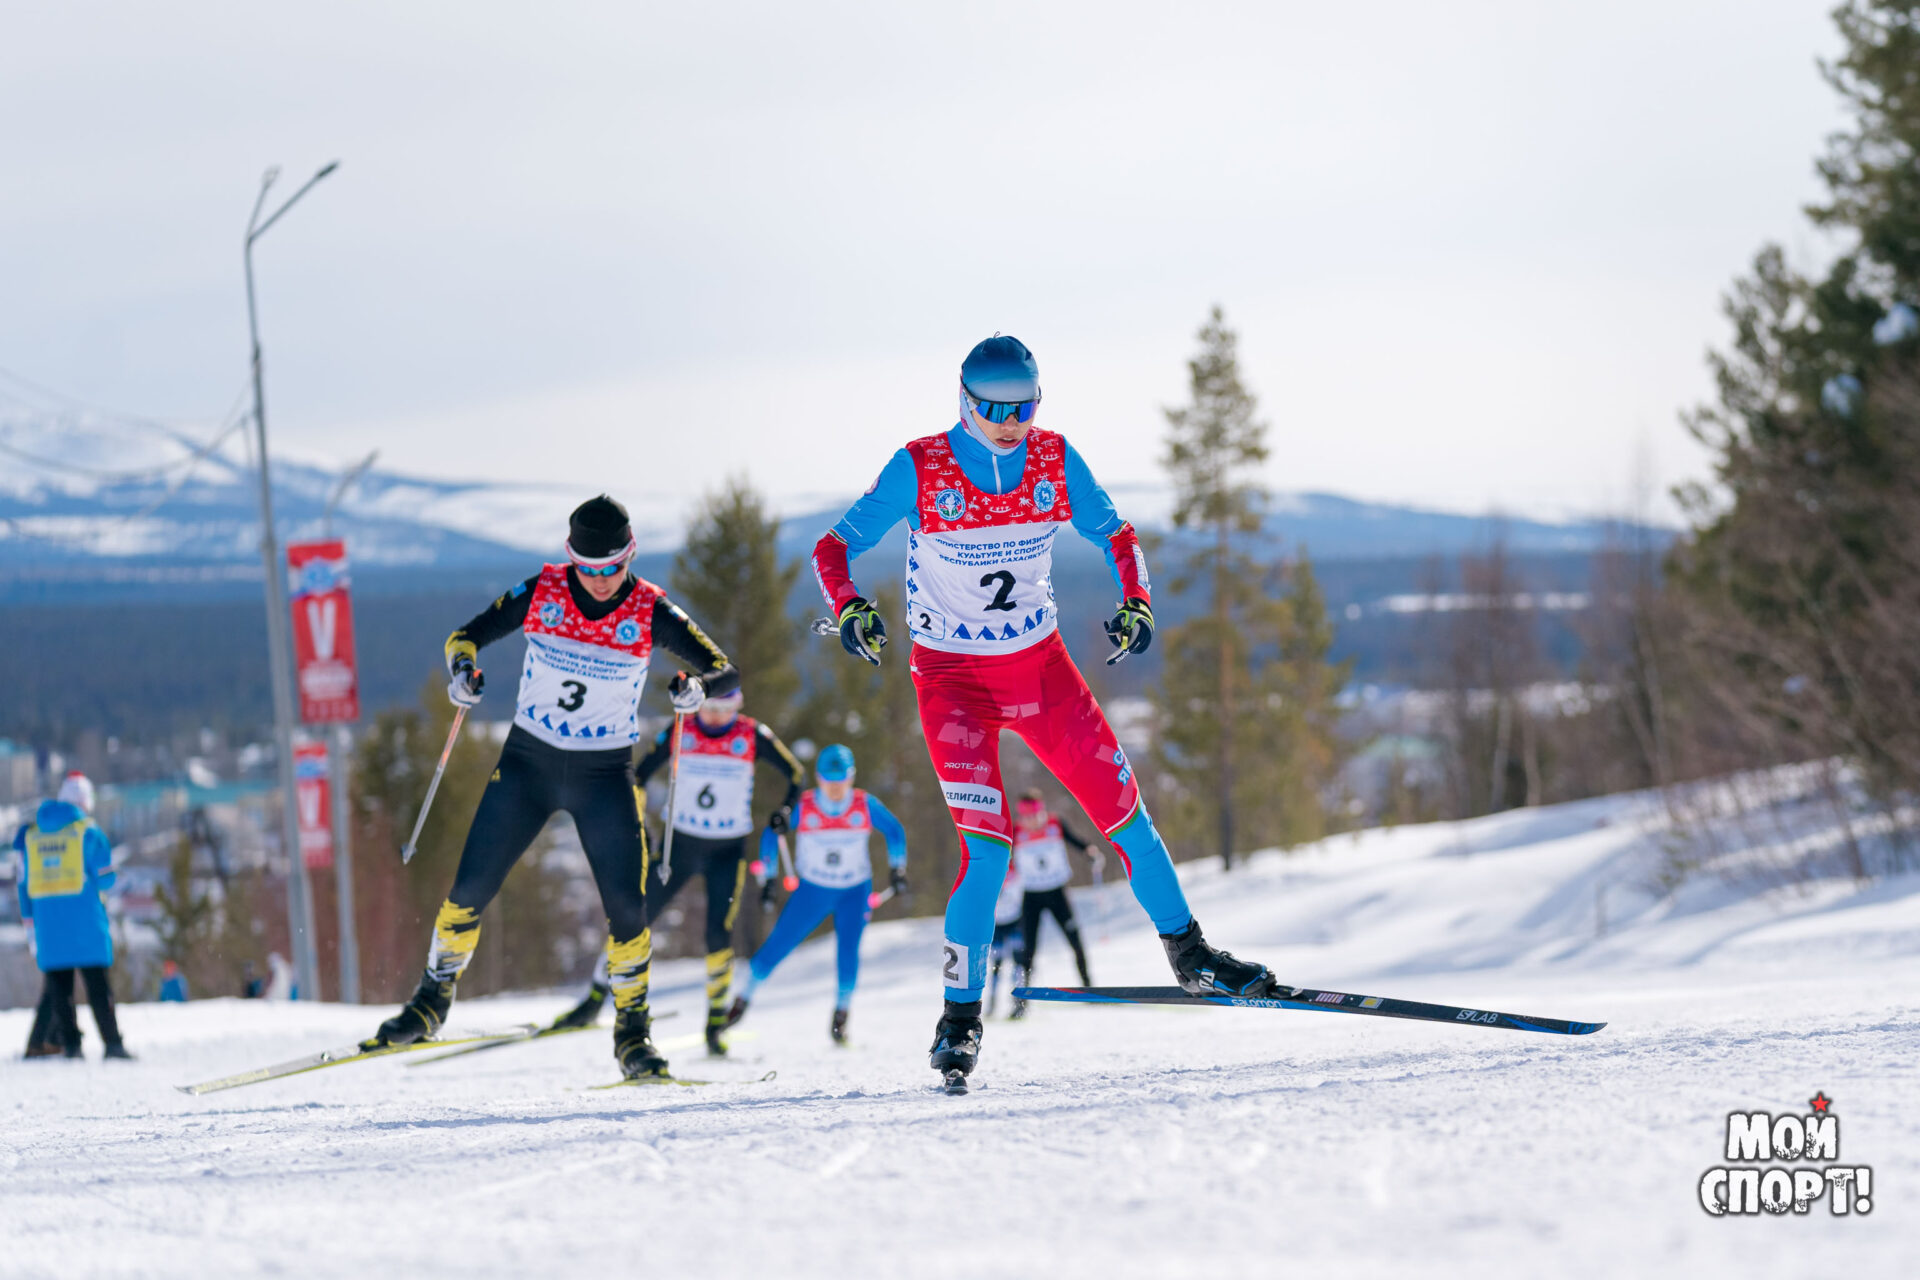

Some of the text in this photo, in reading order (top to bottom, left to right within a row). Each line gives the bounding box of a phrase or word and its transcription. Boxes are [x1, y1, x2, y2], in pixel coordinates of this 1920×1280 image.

[957, 543, 1045, 560] КУЛЬТУРЕ И СПОРТУ
[1003, 540, 1016, 549] ПО
[980, 569, 1018, 612] 2
[919, 612, 932, 631] 2
[557, 680, 587, 712] 3
[944, 762, 988, 773] PROTEAM
[697, 783, 715, 809] 6
[946, 791, 996, 806] СЕЛИГДАР
[943, 945, 959, 981] 2
[1231, 998, 1283, 1009] salomon
